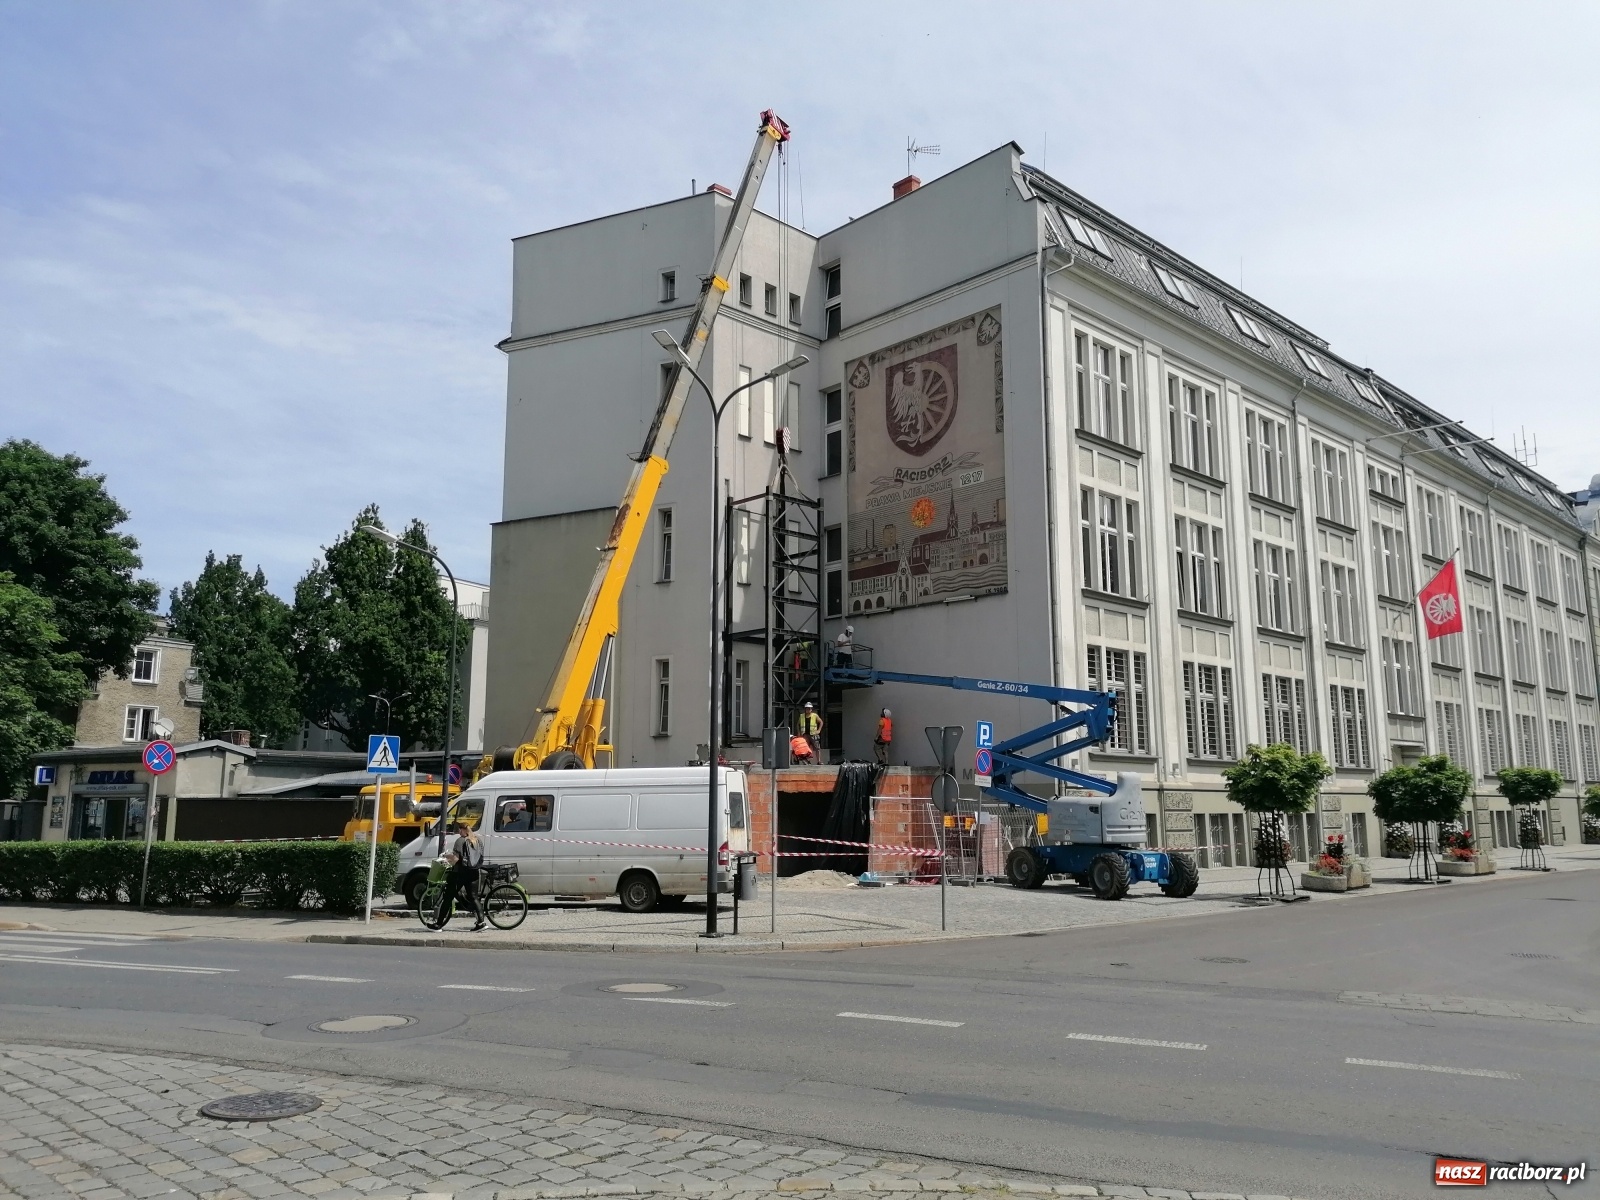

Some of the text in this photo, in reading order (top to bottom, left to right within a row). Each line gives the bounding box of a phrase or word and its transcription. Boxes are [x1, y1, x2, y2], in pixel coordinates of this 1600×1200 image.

[903, 478, 953, 499] MIEJSKIE
[960, 470, 983, 486] 1217
[977, 680, 1029, 694] Genie Z-60/34
[980, 724, 990, 745] P
[41, 769, 52, 782] L
